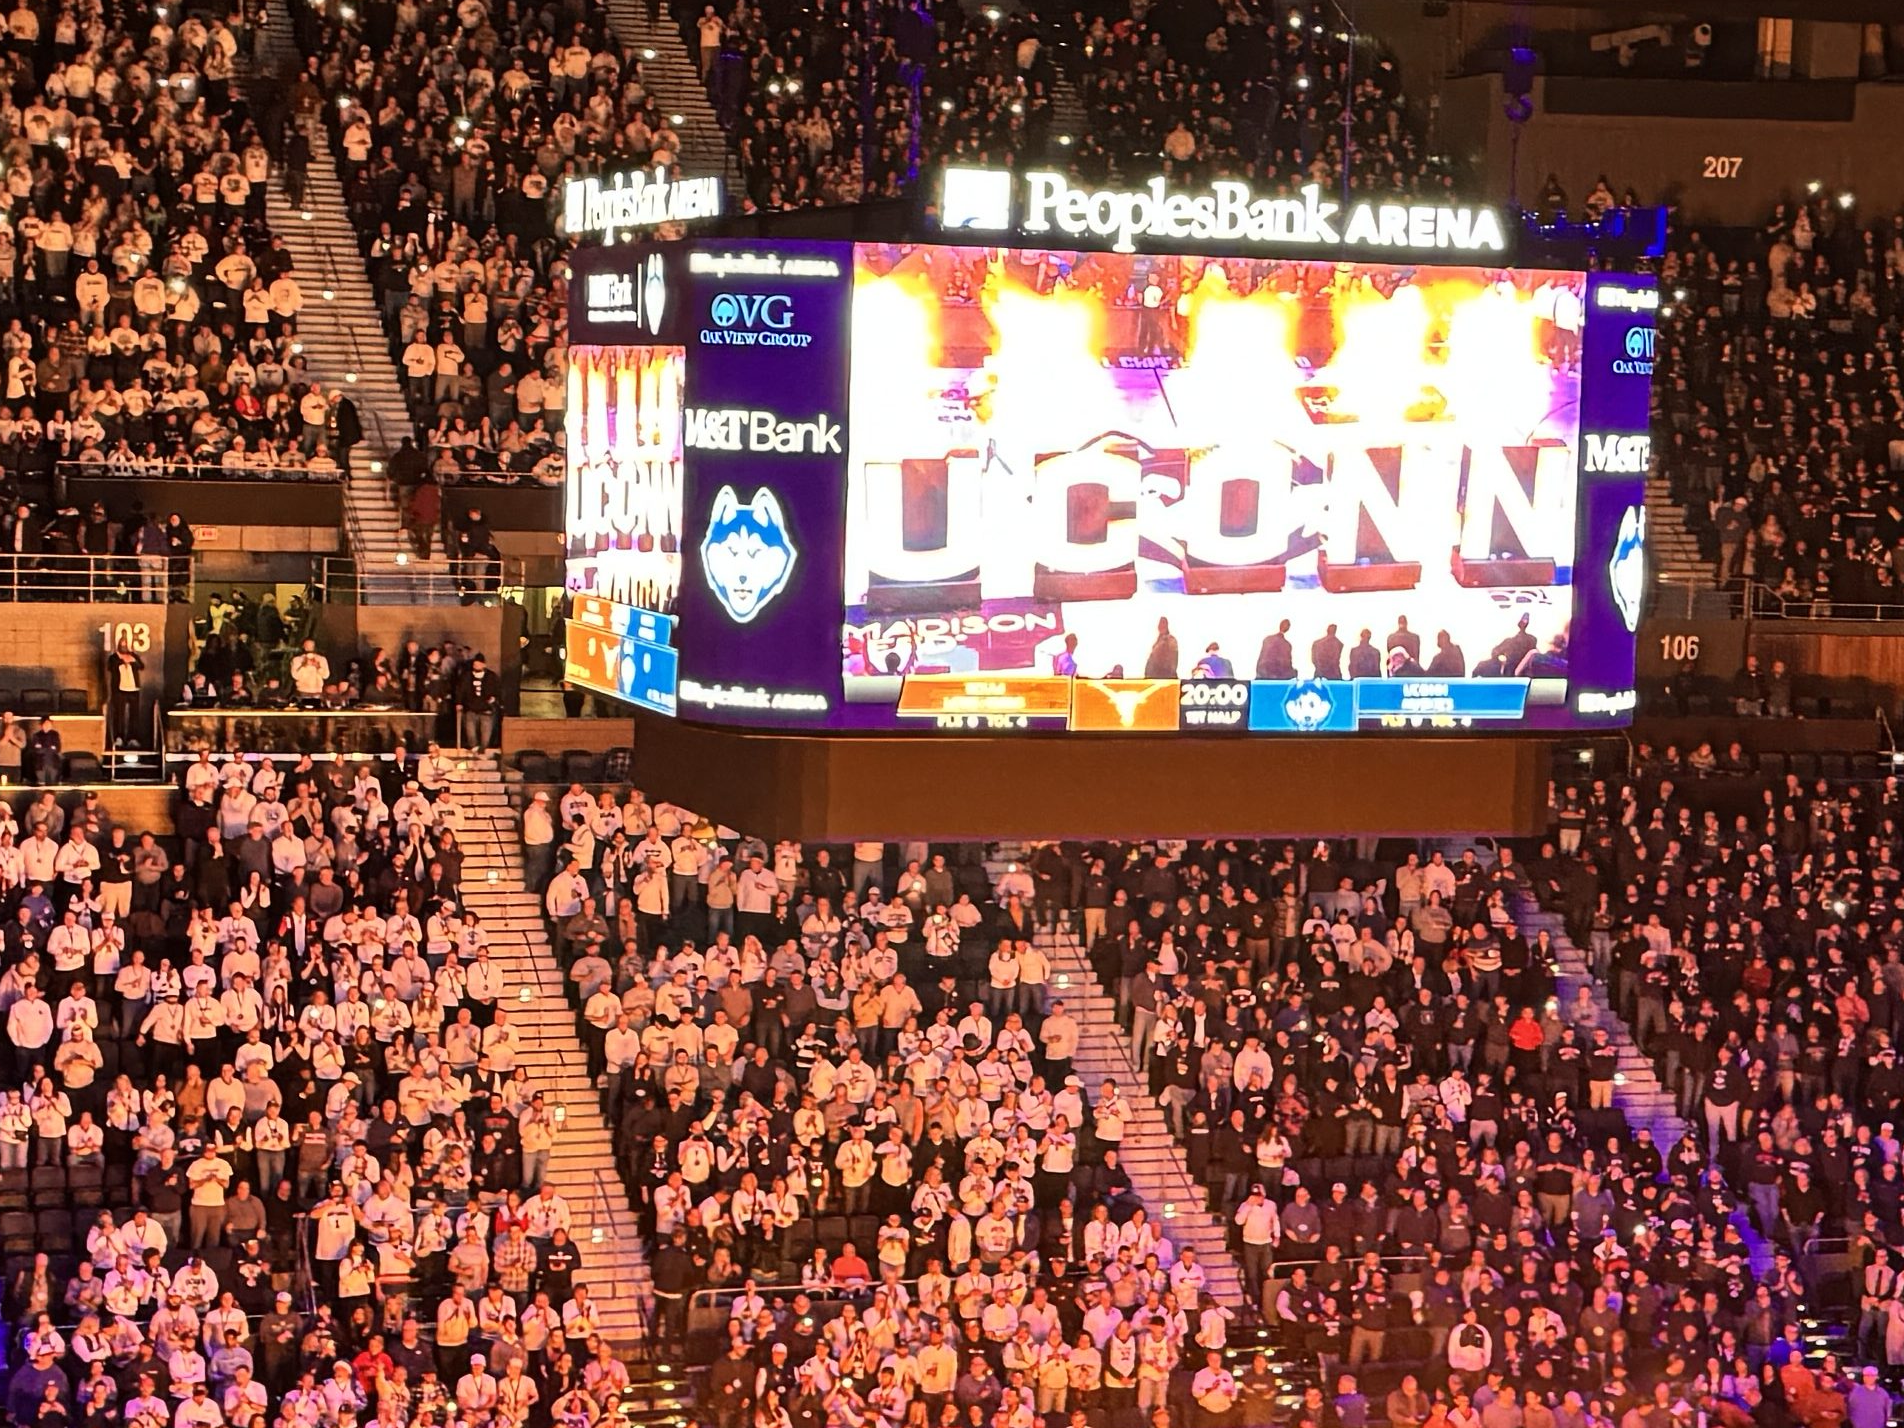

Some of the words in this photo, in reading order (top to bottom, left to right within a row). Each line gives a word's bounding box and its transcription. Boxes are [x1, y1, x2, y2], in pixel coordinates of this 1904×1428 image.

[1703, 156, 1743, 178] 207
[1025, 174, 1339, 252] PeoplesBank
[1344, 204, 1505, 251] ARENA
[711, 293, 795, 329] OVG
[724, 330, 758, 346] VIEW
[758, 331, 812, 347] GROUP
[749, 411, 843, 454] Bank
[99, 622, 151, 652] 103
[1660, 634, 1700, 660] 106
[1181, 683, 1248, 706] 20:00
